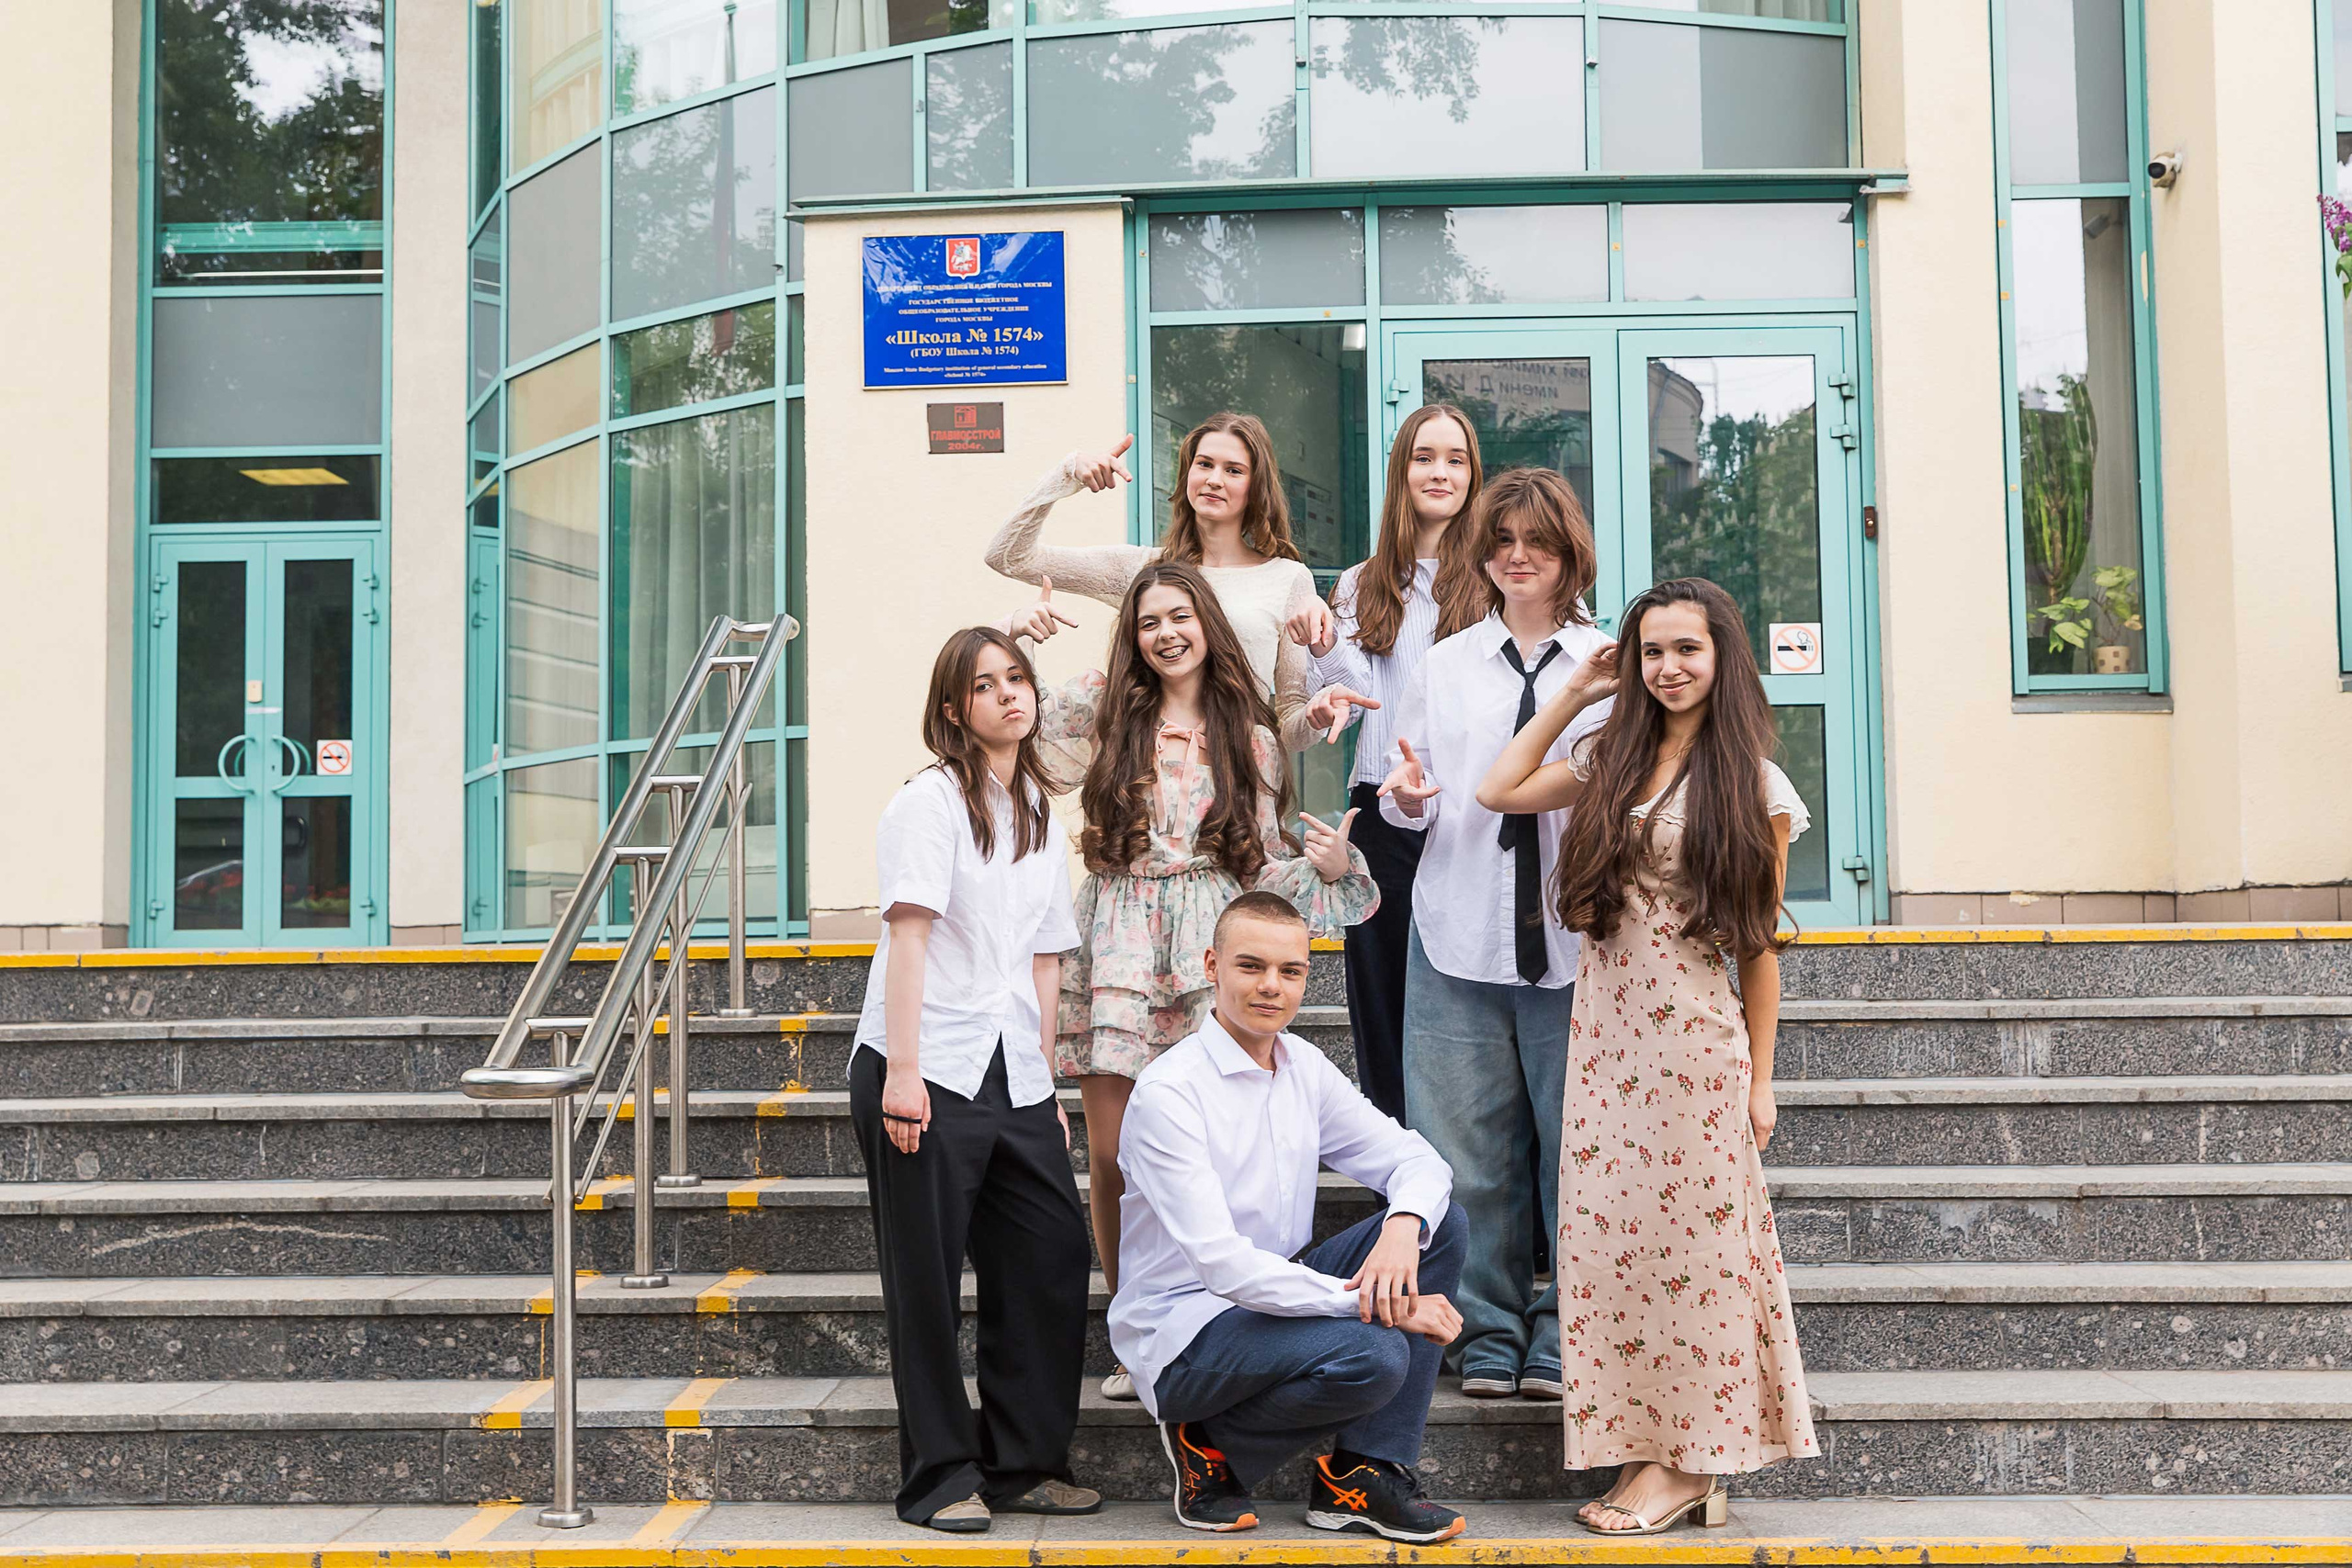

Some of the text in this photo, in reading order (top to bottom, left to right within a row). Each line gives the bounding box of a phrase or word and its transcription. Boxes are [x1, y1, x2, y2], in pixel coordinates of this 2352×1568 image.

[909, 298, 973, 306] ГОСУДАРСТВЕННОЕ
[885, 327, 1045, 345] «Школа № 1574»
[910, 345, 1020, 359] (ГБОУ Школа № 1574)
[948, 442, 985, 450] 2004г.
